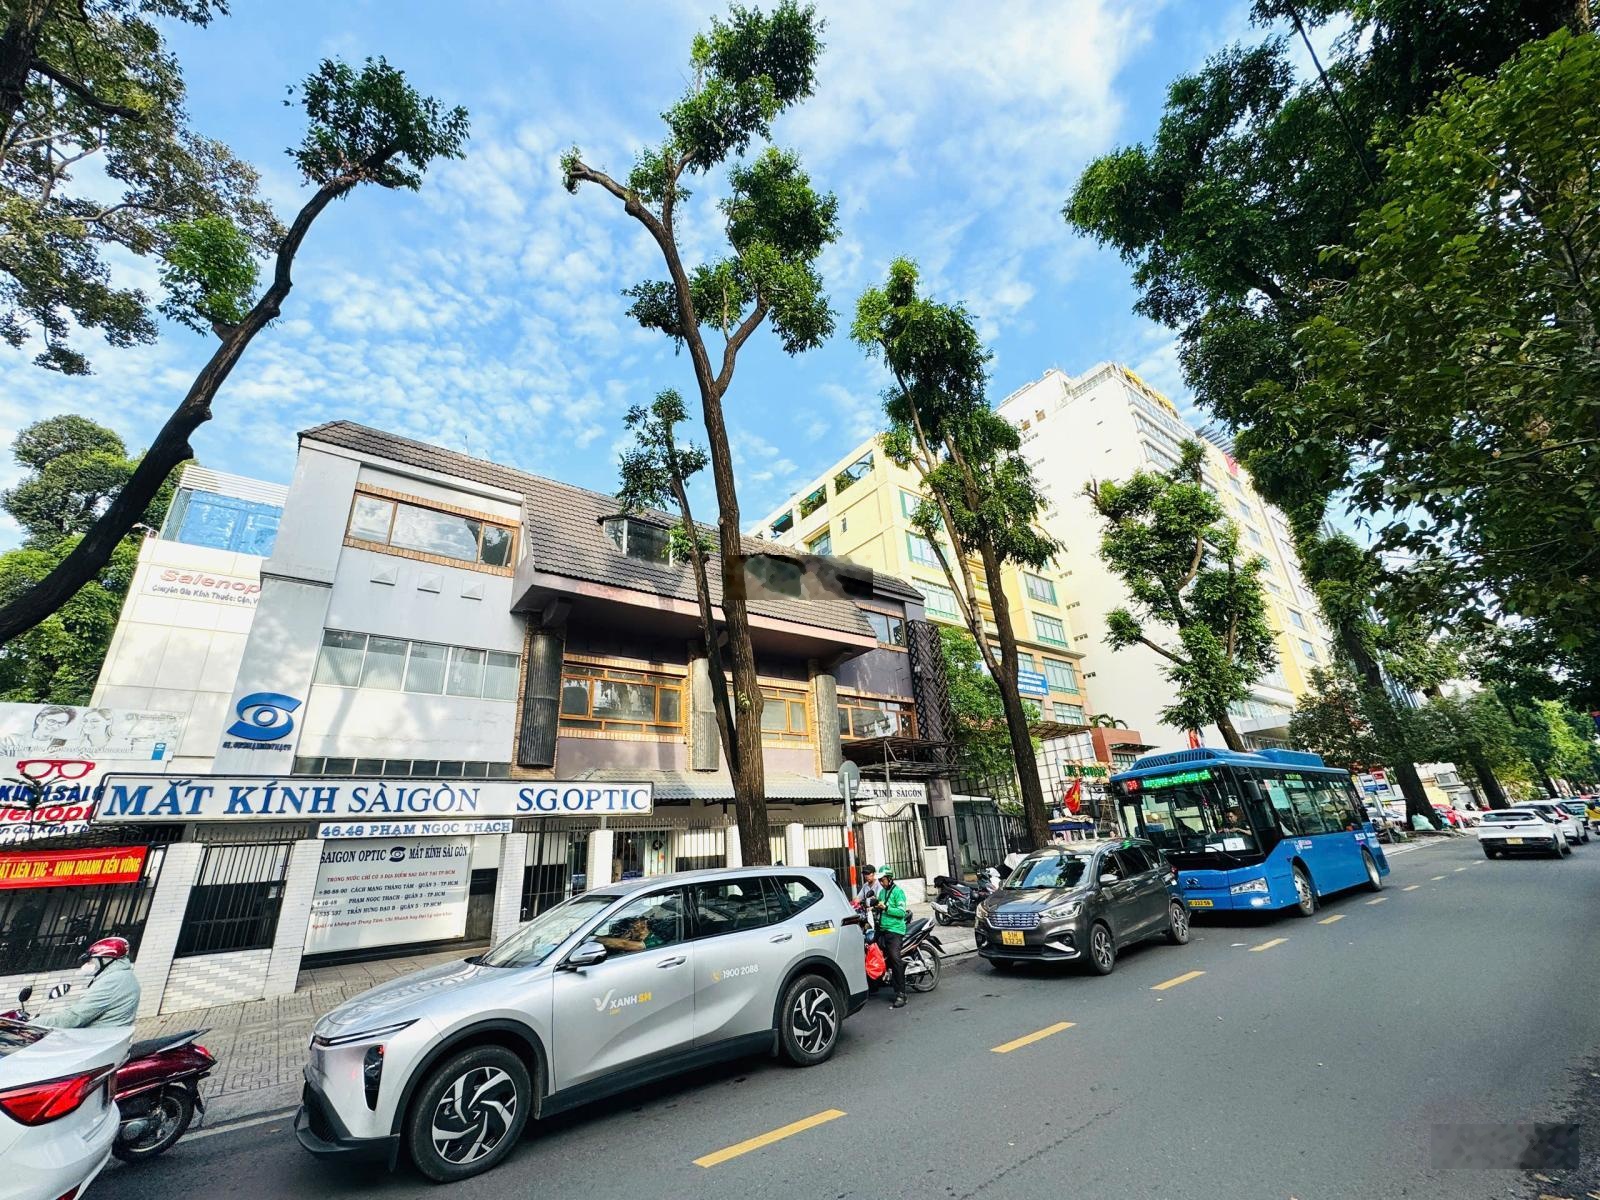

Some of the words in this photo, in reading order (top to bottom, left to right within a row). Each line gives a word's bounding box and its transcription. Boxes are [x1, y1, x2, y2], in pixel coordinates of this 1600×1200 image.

[180, 587, 191, 596] Gia
[193, 589, 210, 599] Kính
[102, 781, 213, 816] MẮT
[222, 781, 340, 814] KÍNH
[321, 825, 364, 837] 46.48
[369, 824, 416, 836] PHẠM
[421, 823, 460, 834] NGỌC
[464, 822, 511, 833] THẠCH
[320, 850, 357, 864] SAIGON
[358, 849, 387, 862] OPTIC
[424, 844, 441, 859] KÍNH
[10, 859, 32, 879] LIÊN
[53, 860, 75, 876] KINH
[73, 859, 104, 876] DOANH
[722, 967, 740, 980] 1900
[610, 994, 638, 1010] XANH
